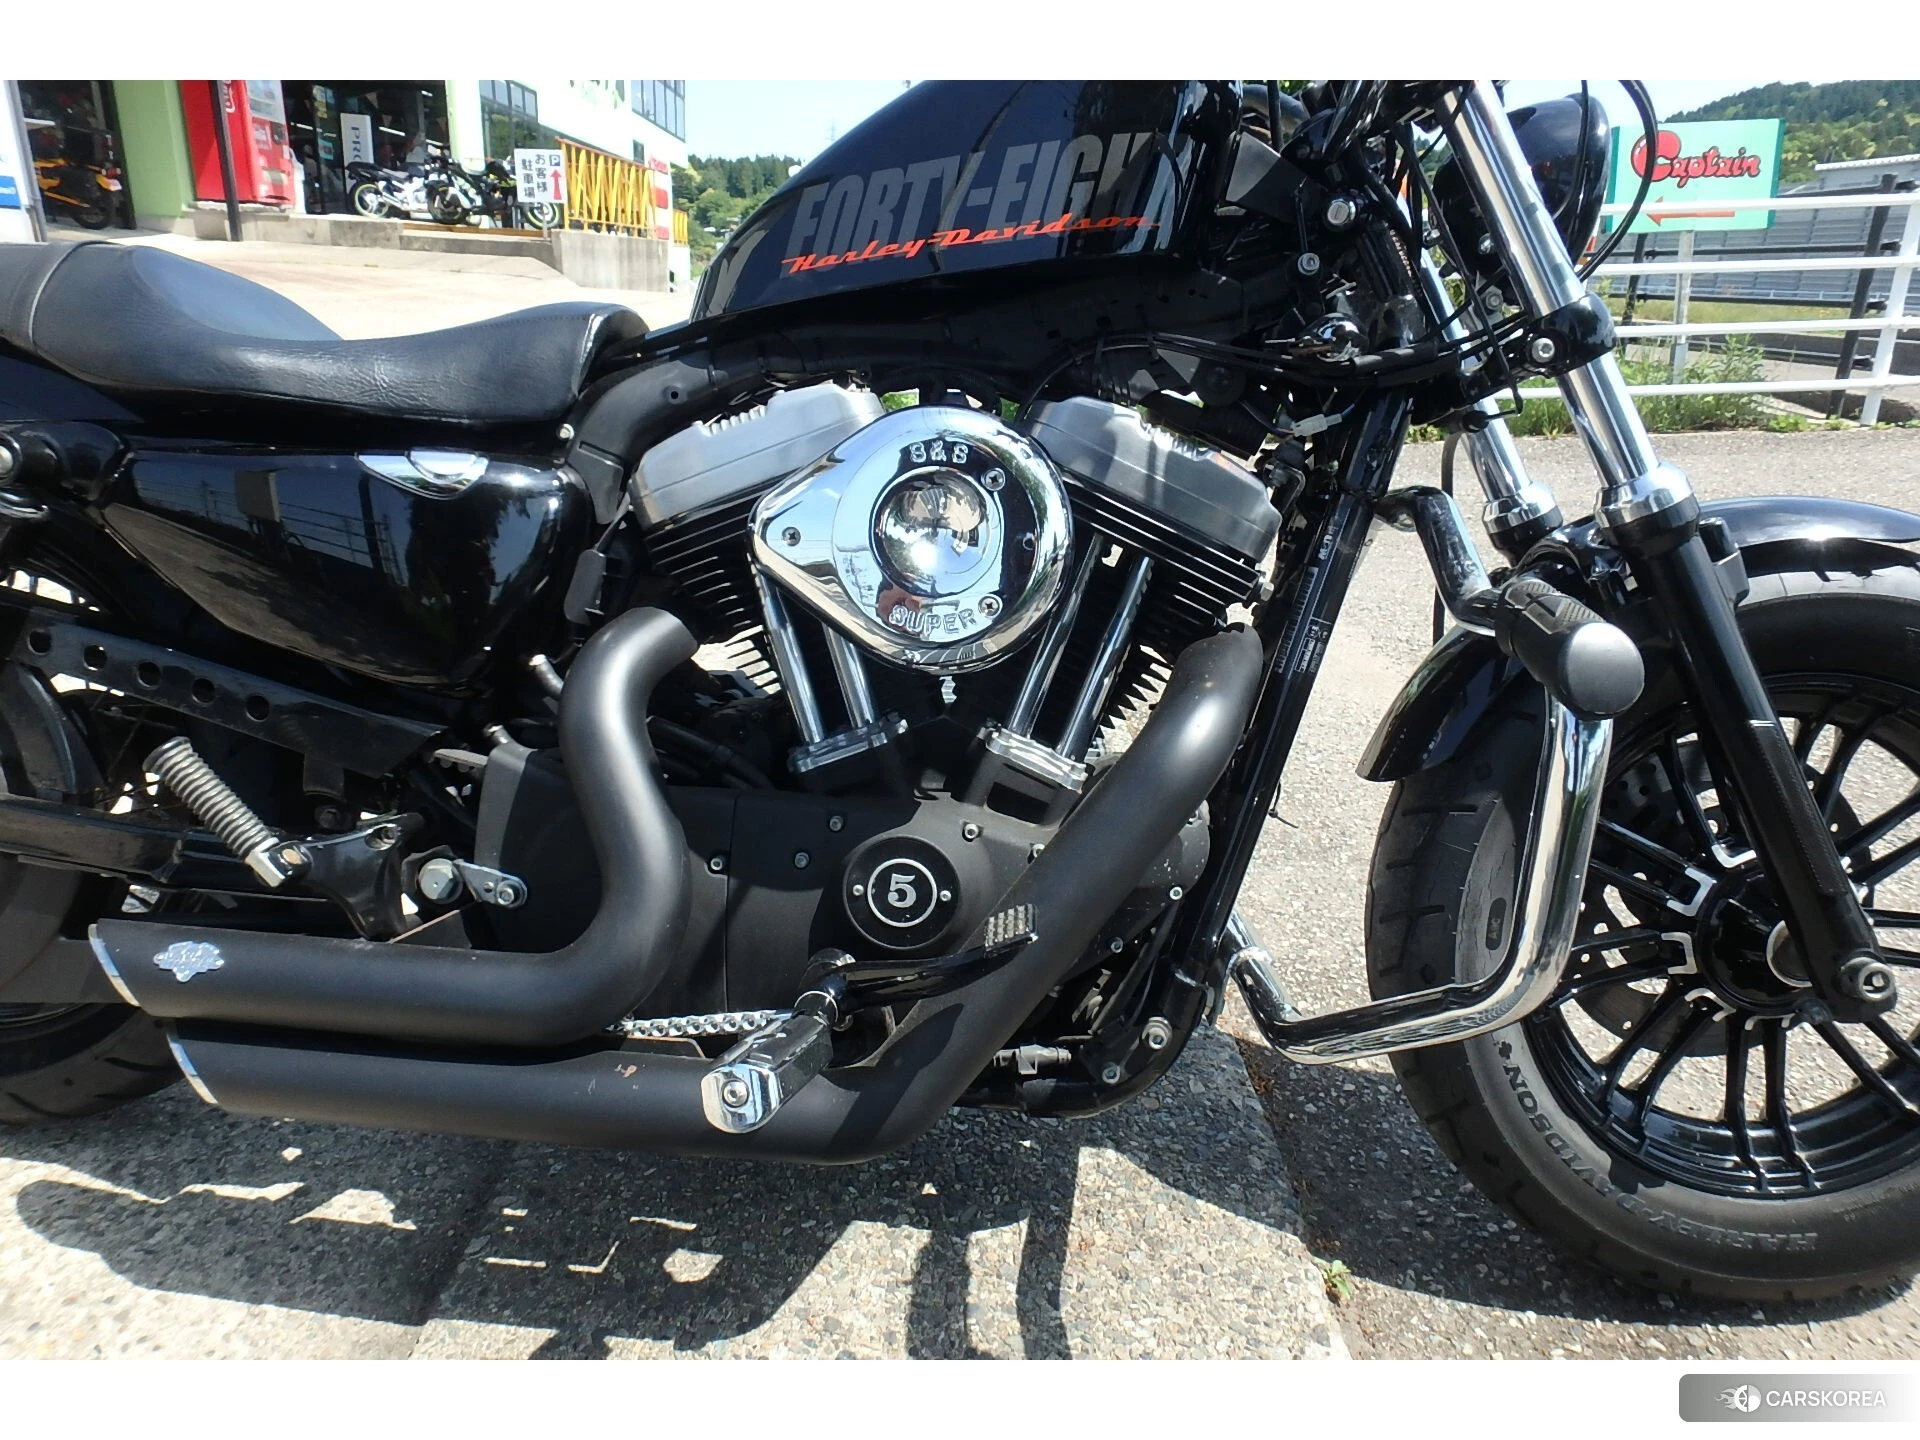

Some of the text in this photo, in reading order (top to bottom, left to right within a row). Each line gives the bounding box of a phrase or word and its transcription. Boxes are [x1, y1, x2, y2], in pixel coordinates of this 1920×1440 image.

[521, 158, 536, 199] 駐車場
[535, 153, 548, 193] お客様
[1631, 130, 1761, 188] Captain
[782, 212, 1160, 275] Harley-Davidson
[909, 440, 969, 464] S&S
[888, 604, 977, 637] SUPER
[887, 873, 917, 908] 5
